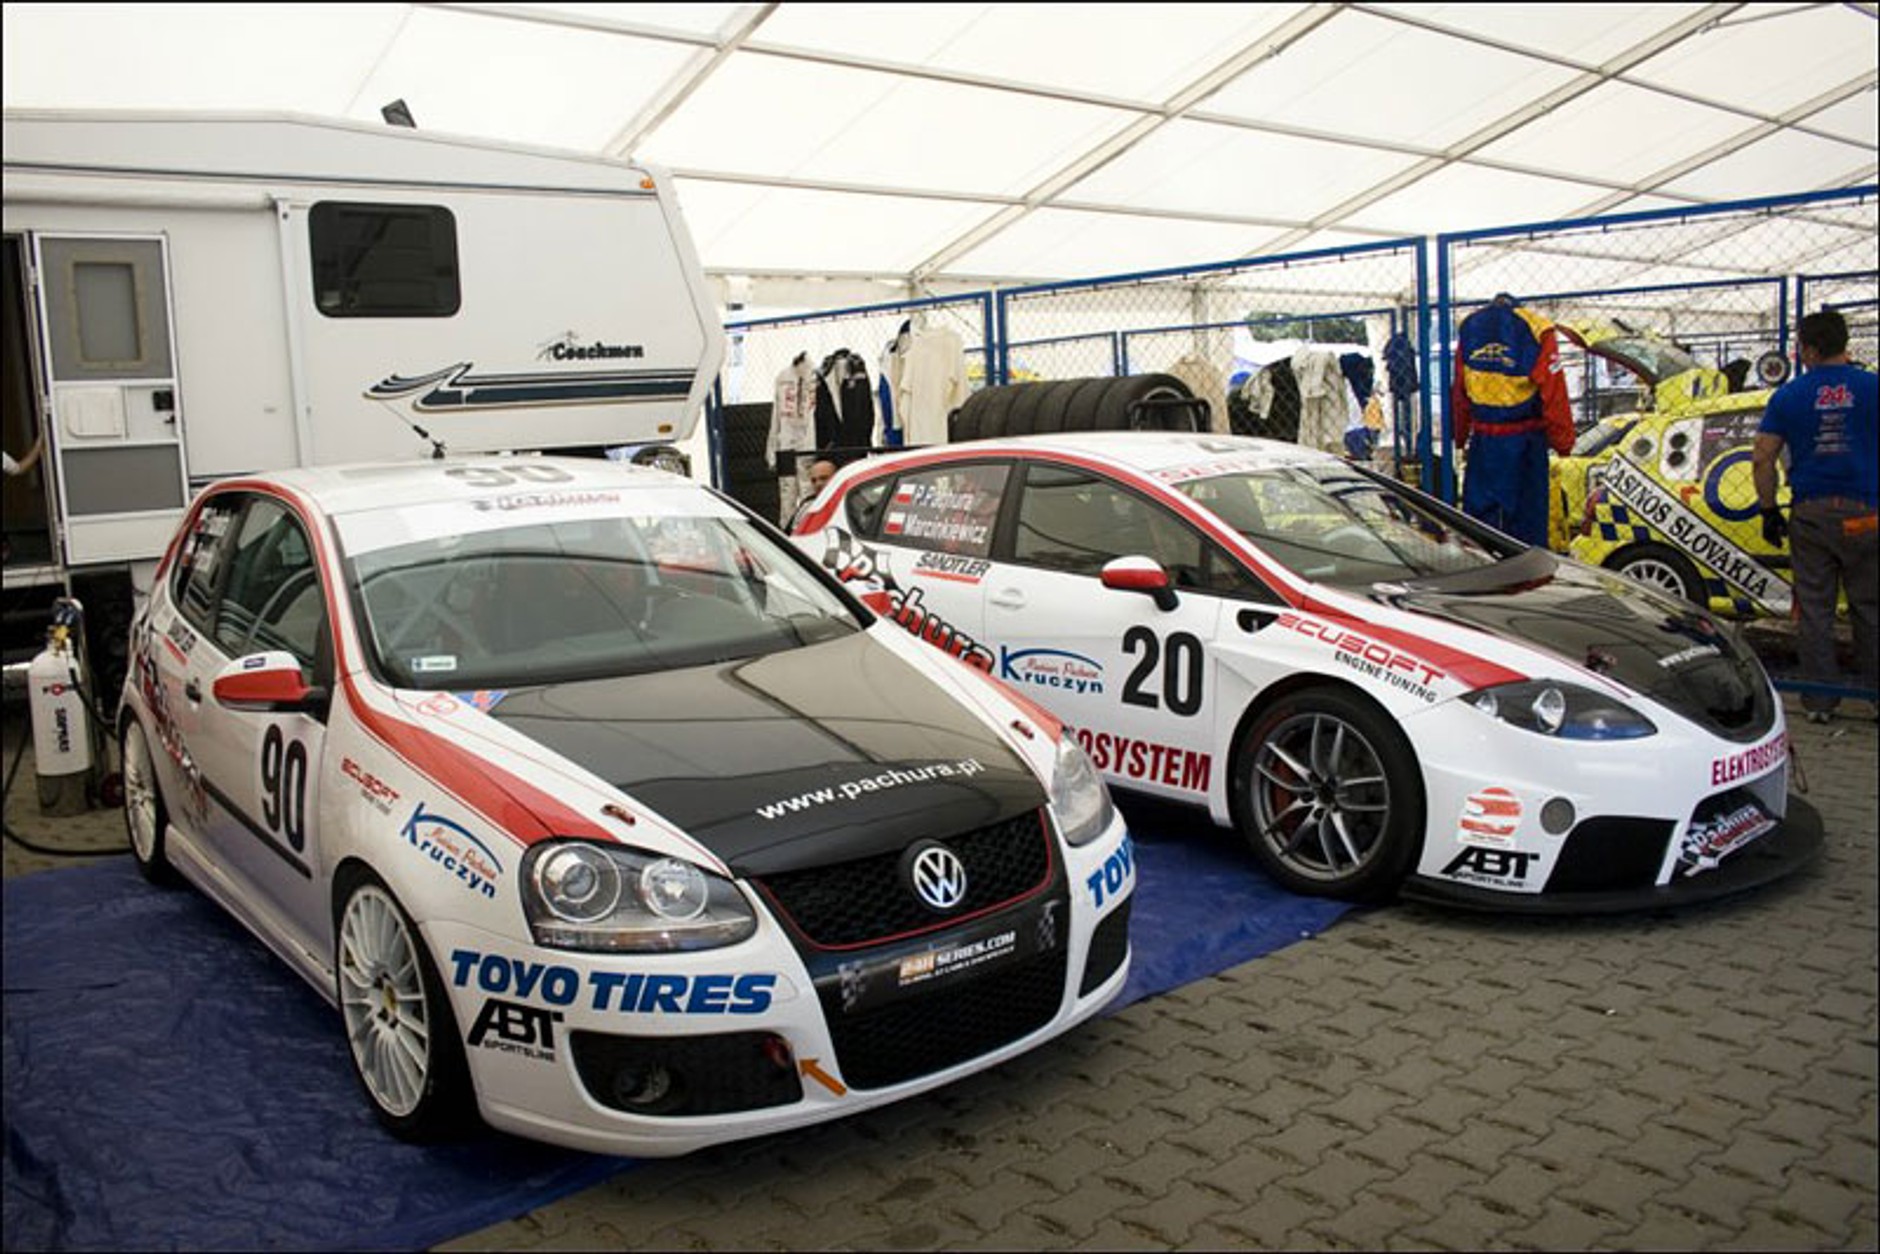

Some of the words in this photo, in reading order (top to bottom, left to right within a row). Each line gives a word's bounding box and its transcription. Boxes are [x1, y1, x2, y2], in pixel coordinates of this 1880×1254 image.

[1608, 456, 1672, 524] CASINOS
[1668, 515, 1771, 598] SLOVAKIA
[1000, 645, 1104, 694] Kruczyn
[1121, 625, 1204, 718] 20
[1334, 651, 1383, 680] ENGINE
[1383, 670, 1438, 704] TUNING
[261, 722, 307, 854] 90
[755, 757, 987, 820] www.pachura.pl
[1072, 728, 1212, 792] OSYSTEM
[400, 801, 498, 899] Kruczyn
[1086, 829, 1135, 909] TOY
[1440, 845, 1540, 880] ABT
[451, 949, 580, 1006] TOYO
[588, 970, 777, 1014] TIRES
[467, 998, 563, 1048] ABT
